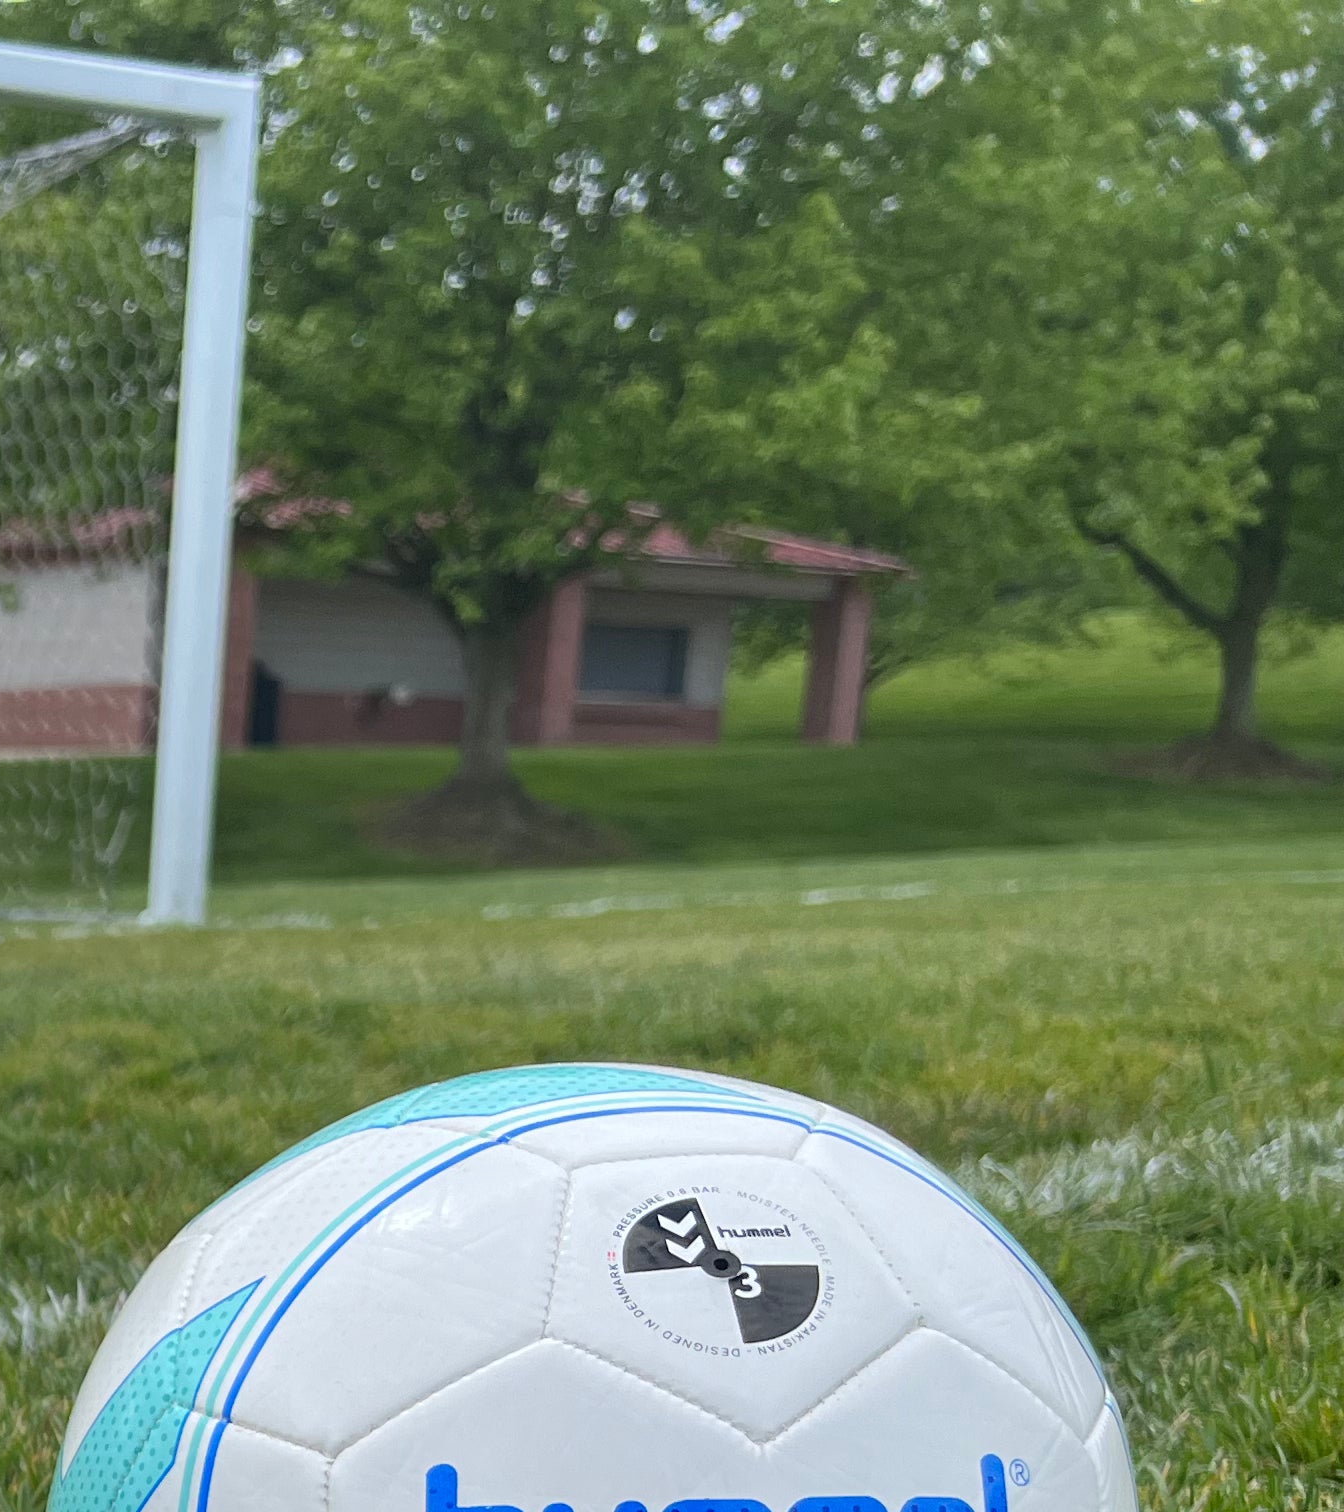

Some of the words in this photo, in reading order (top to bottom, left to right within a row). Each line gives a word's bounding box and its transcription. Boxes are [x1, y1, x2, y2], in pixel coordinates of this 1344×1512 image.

[613, 1193, 665, 1238] PRESSURE
[717, 1225, 791, 1238] hummel
[799, 1223, 833, 1266] NEEDLE
[608, 1263, 645, 1319] DENMARK
[734, 1265, 762, 1299] 3
[818, 1275, 835, 1308] MADE
[643, 1318, 660, 1331] IN
[811, 1308, 828, 1323] IN
[662, 1329, 741, 1358] DESIGNED
[758, 1323, 817, 1355] PAKISTAN
